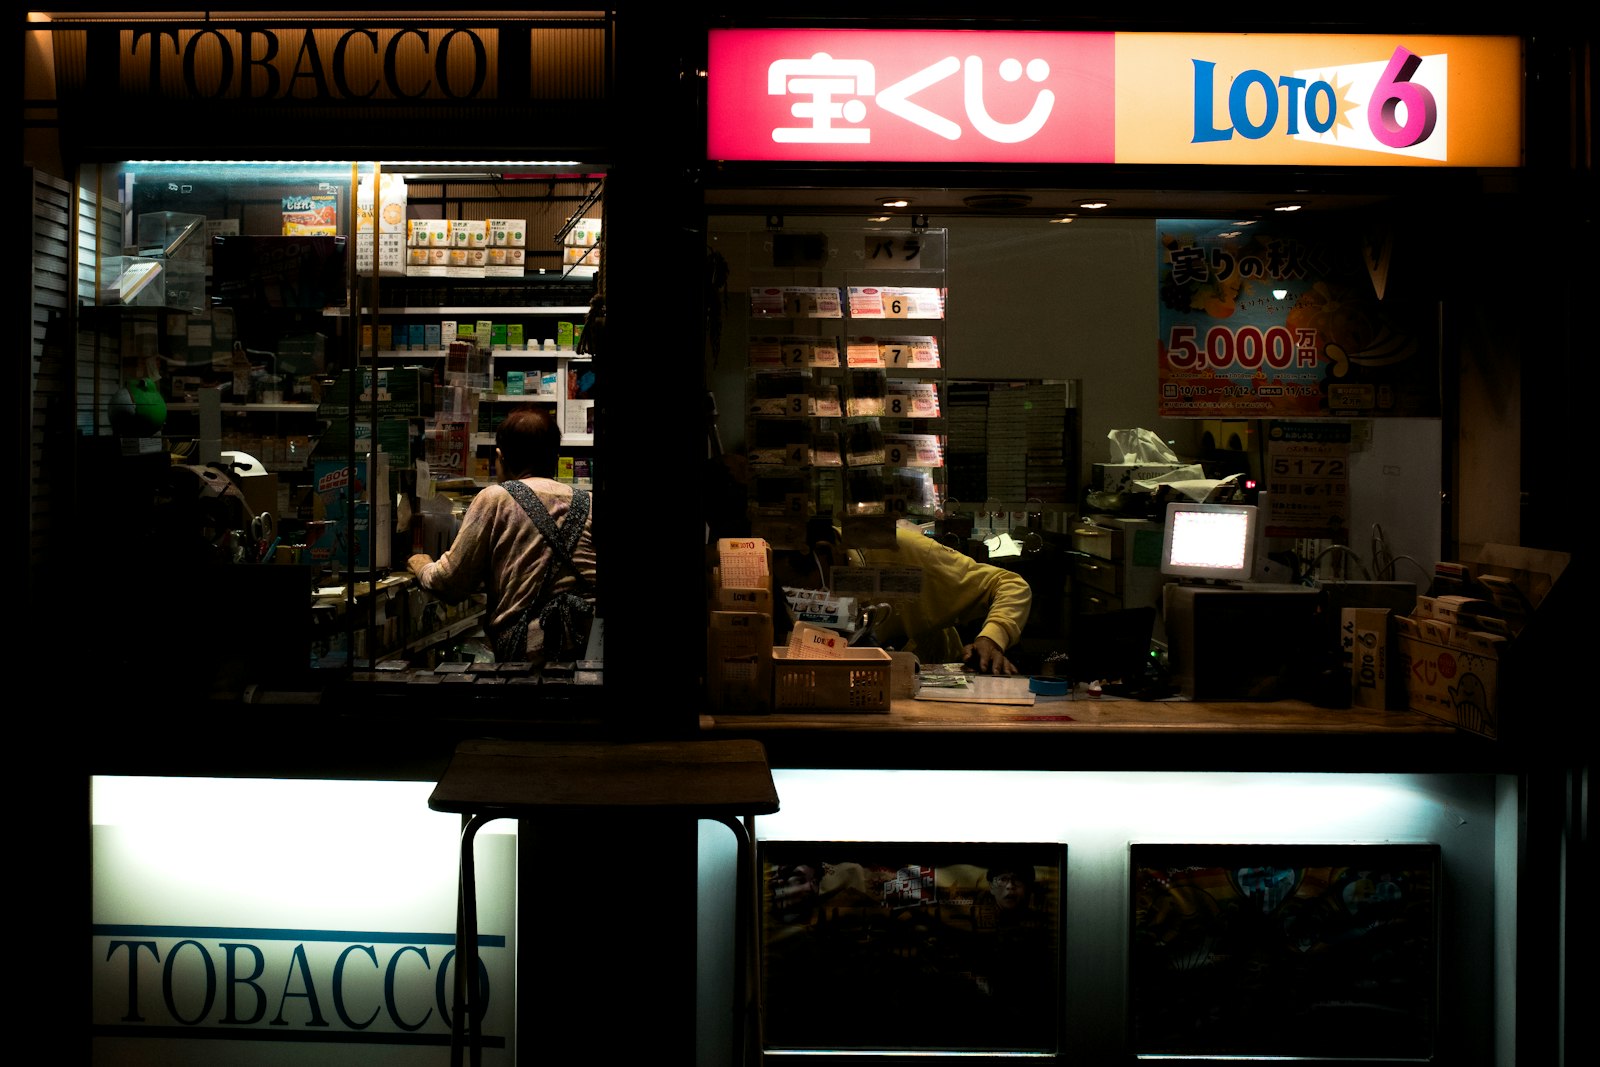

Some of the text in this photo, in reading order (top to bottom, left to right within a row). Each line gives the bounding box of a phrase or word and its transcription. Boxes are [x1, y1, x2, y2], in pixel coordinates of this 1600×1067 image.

[130, 27, 487, 100] TOBACCO
[767, 51, 1055, 144] 宝くじ
[1190, 44, 1437, 148] LOTO 6
[872, 239, 921, 260] バラ
[1169, 240, 1332, 286] 実りの秋く
[891, 300, 901, 314] 6
[792, 348, 802, 362] 2
[891, 349, 901, 363] 7
[792, 398, 802, 412] 3
[891, 399, 901, 413] 8
[791, 449, 801, 462] 4
[891, 448, 901, 463] 9
[1274, 459, 1344, 475] 5172
[1357, 633, 1377, 689] LOTO 6
